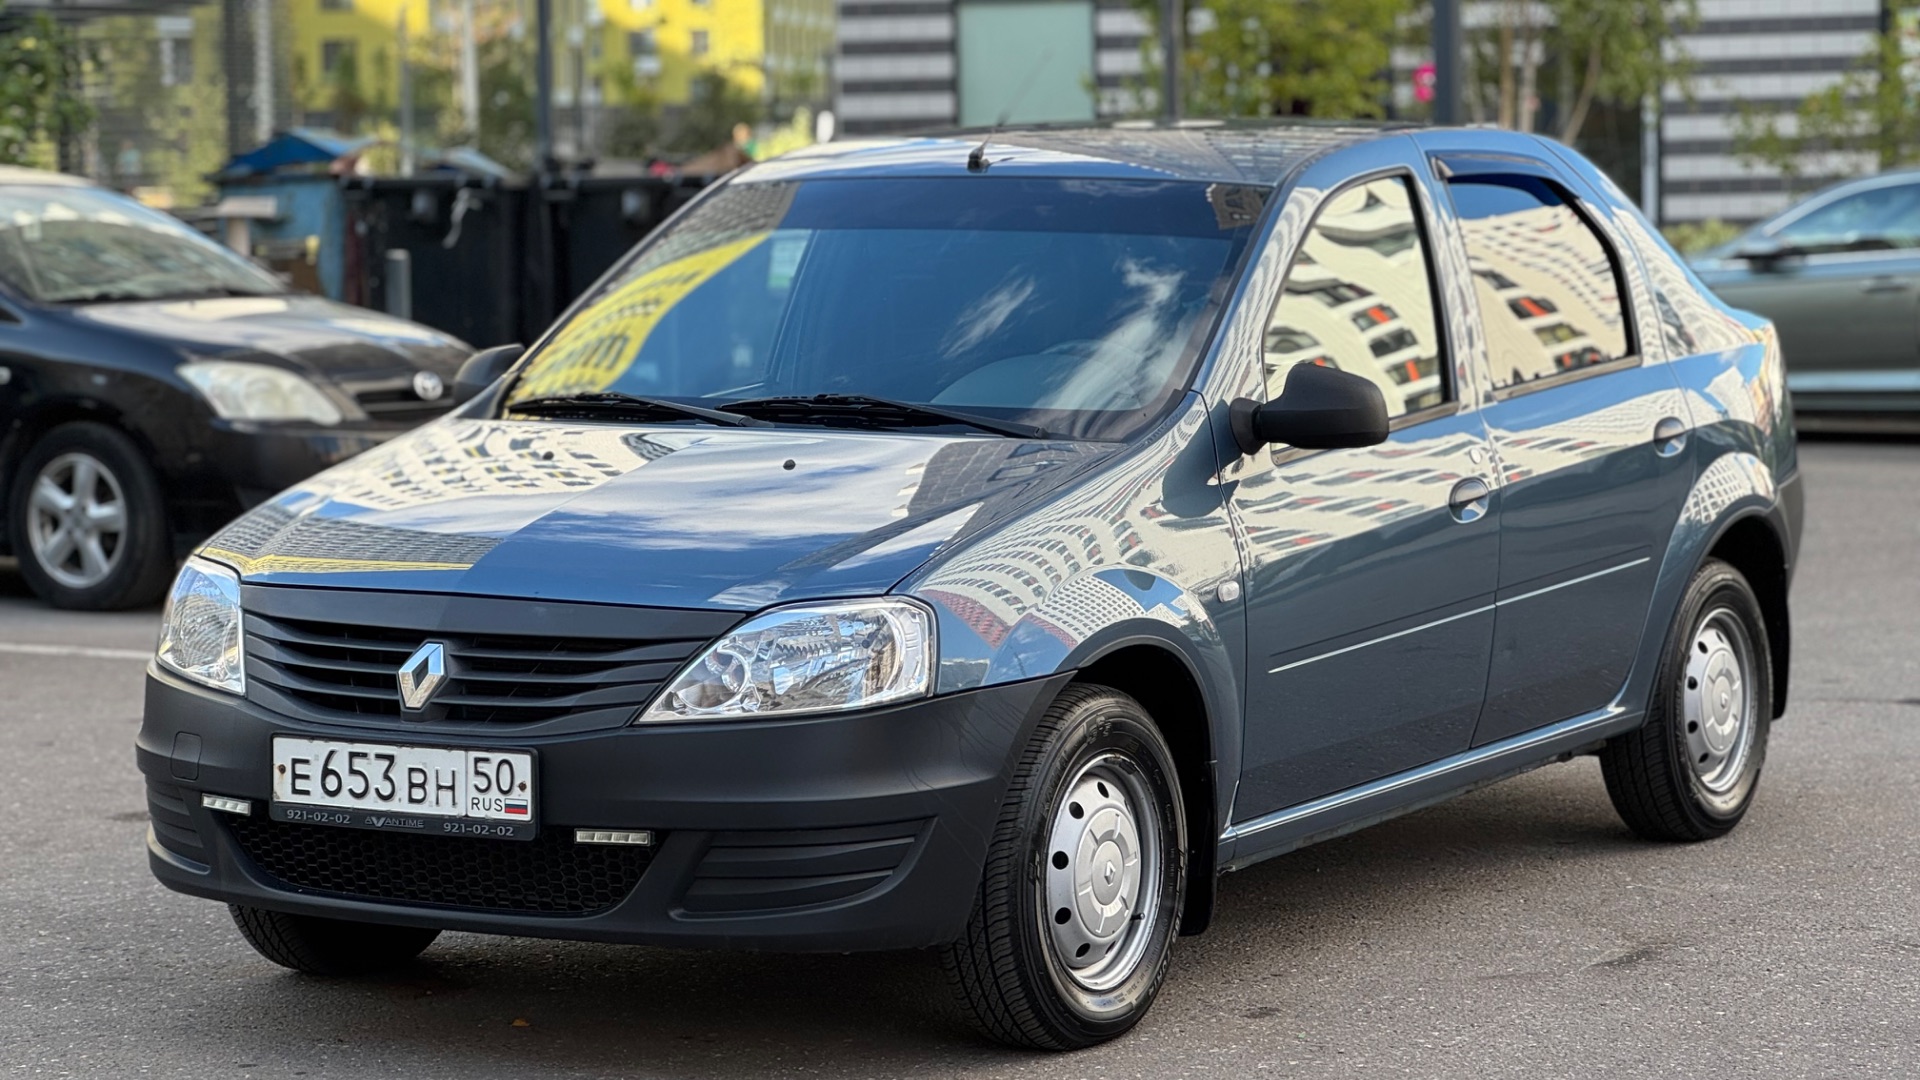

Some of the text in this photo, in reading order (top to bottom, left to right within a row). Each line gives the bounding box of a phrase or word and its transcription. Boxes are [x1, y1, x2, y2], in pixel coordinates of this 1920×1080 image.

[473, 757, 515, 796] 50
[471, 796, 503, 813] RUS
[286, 809, 351, 824] 921-02-02
[443, 822, 514, 837] 921-02-02
